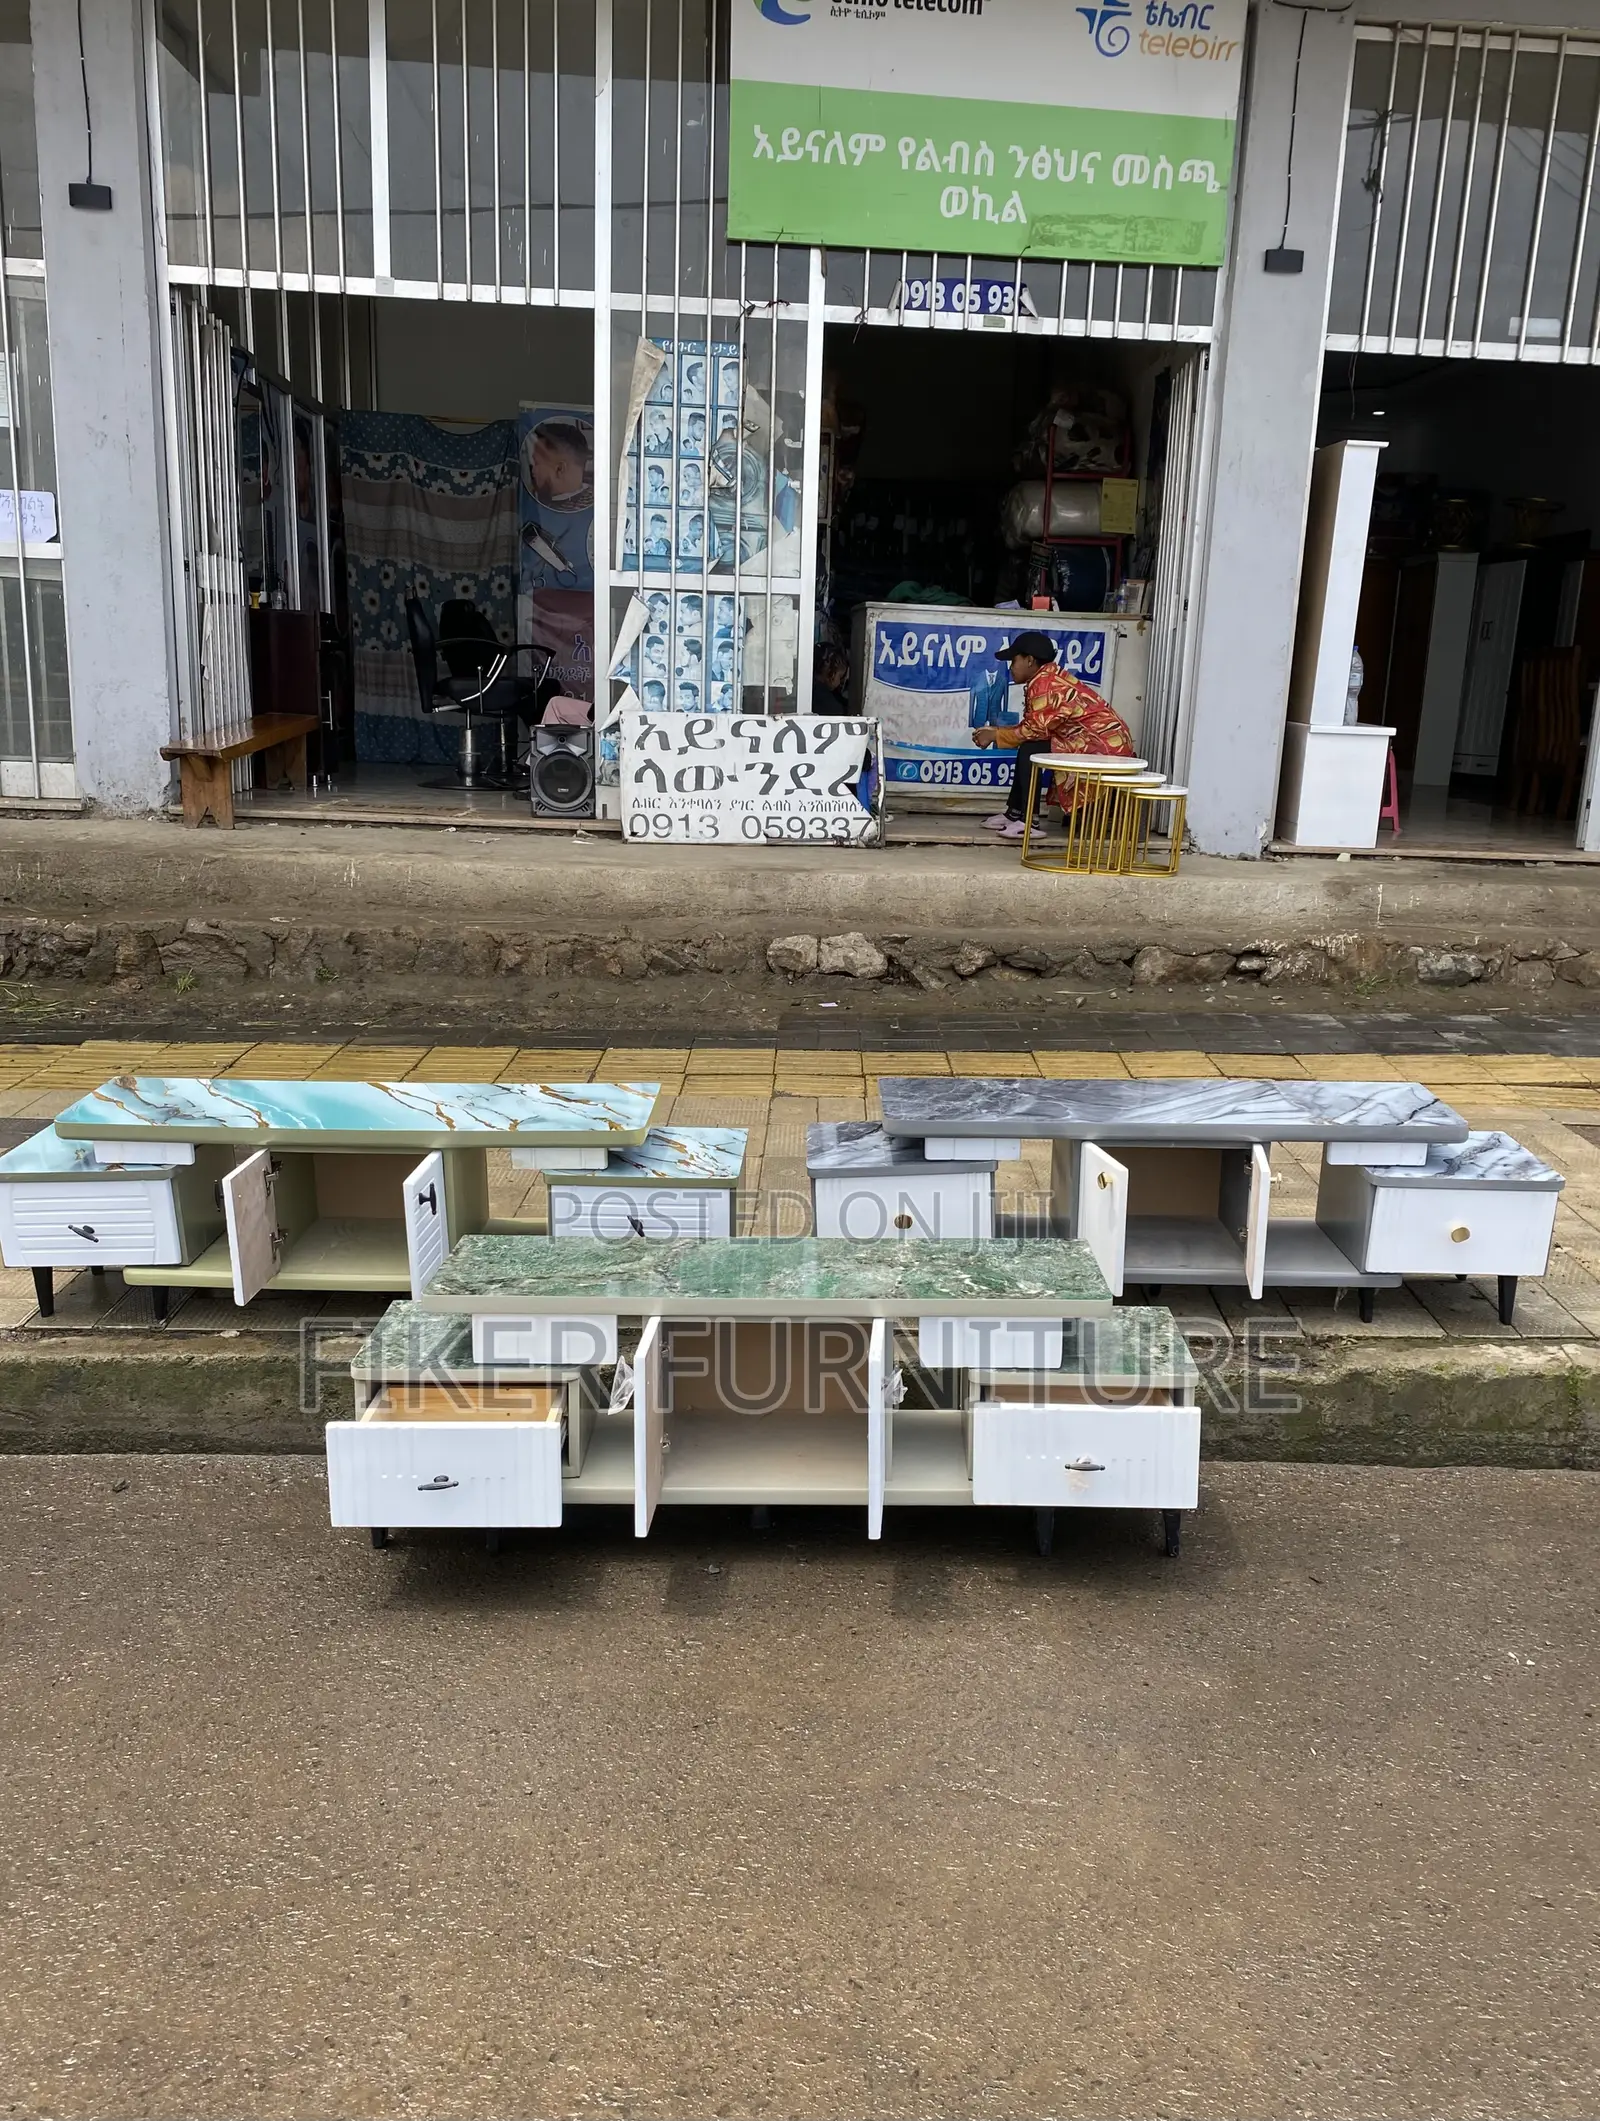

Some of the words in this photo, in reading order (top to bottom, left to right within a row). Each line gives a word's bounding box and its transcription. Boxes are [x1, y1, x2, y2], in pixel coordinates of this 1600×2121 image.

[1138, 28, 1240, 62] telebirr
[752, 124, 887, 166] አይናለም
[898, 136, 995, 177] የልብስ
[1008, 144, 1102, 184] ንፅህና
[1112, 153, 1221, 193] መስጫ
[940, 185, 1028, 225] ወኪል
[951, 283, 981, 312] 05
[877, 630, 987, 668] አይናለም
[634, 714, 869, 756] አይናለም
[920, 760, 963, 784] 0913
[968, 762, 992, 785] 05
[629, 813, 720, 839] 0913
[741, 815, 873, 840] 059337
